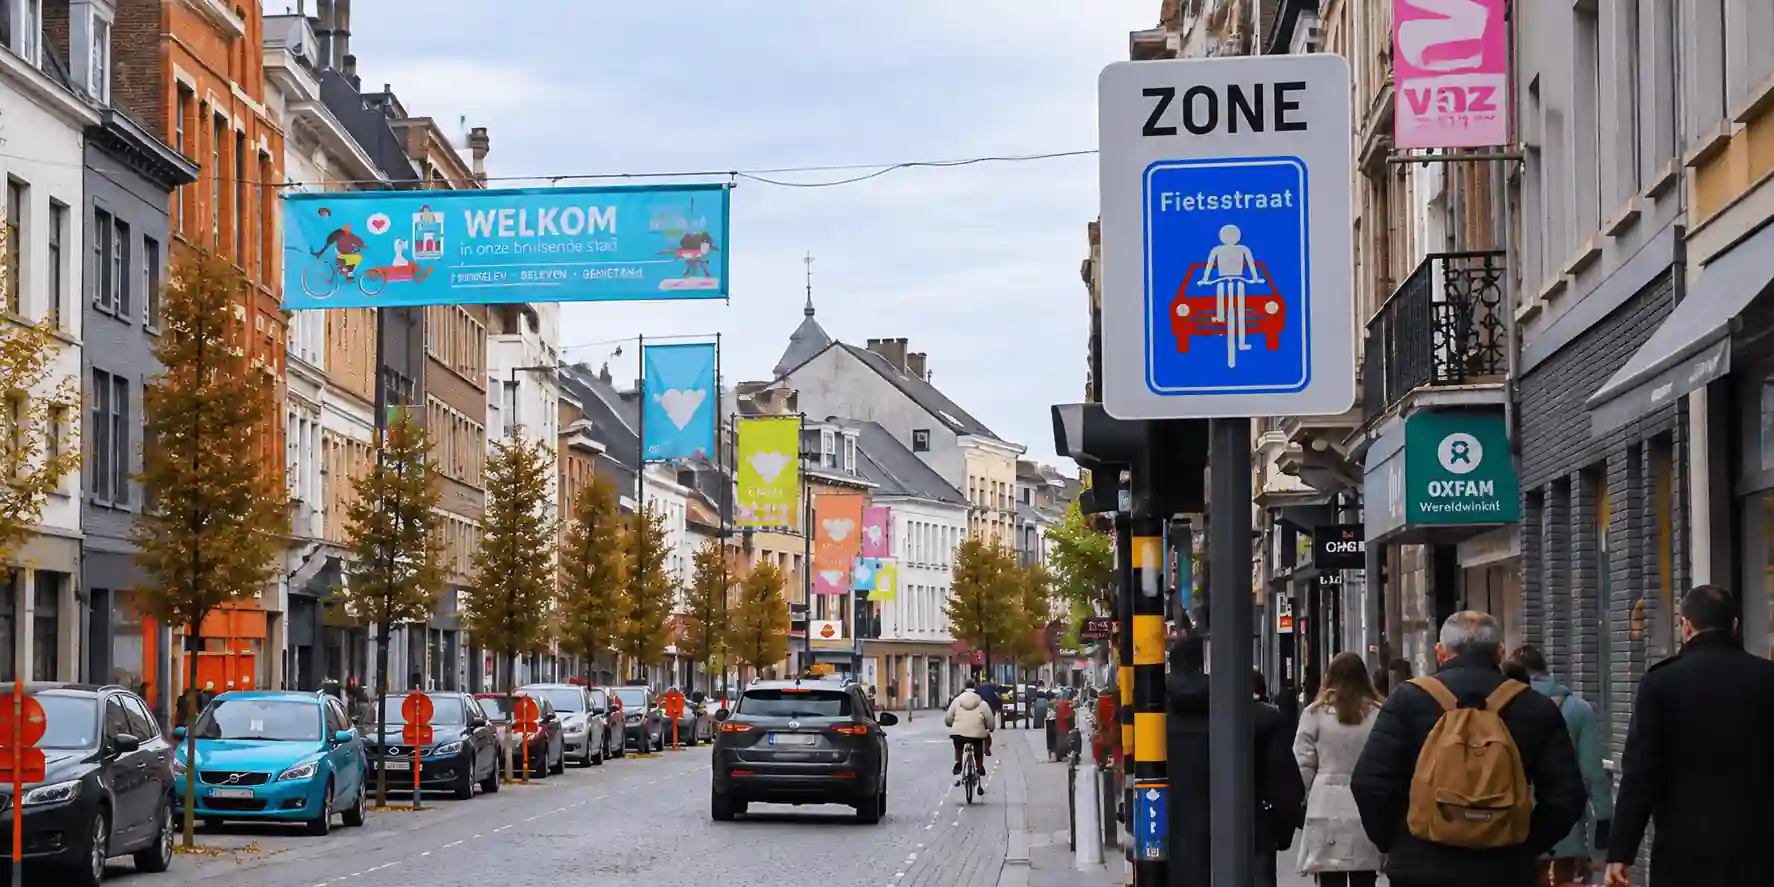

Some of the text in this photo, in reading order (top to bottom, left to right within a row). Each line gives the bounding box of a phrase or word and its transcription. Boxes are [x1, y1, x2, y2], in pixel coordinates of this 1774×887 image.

[1142, 81, 1308, 137] ZONE
[1161, 189, 1293, 212] Fietsstraat
[464, 205, 617, 238] WELKOM
[461, 243, 473, 256] in
[476, 244, 509, 256] onze
[1428, 479, 1494, 498] OXFAM
